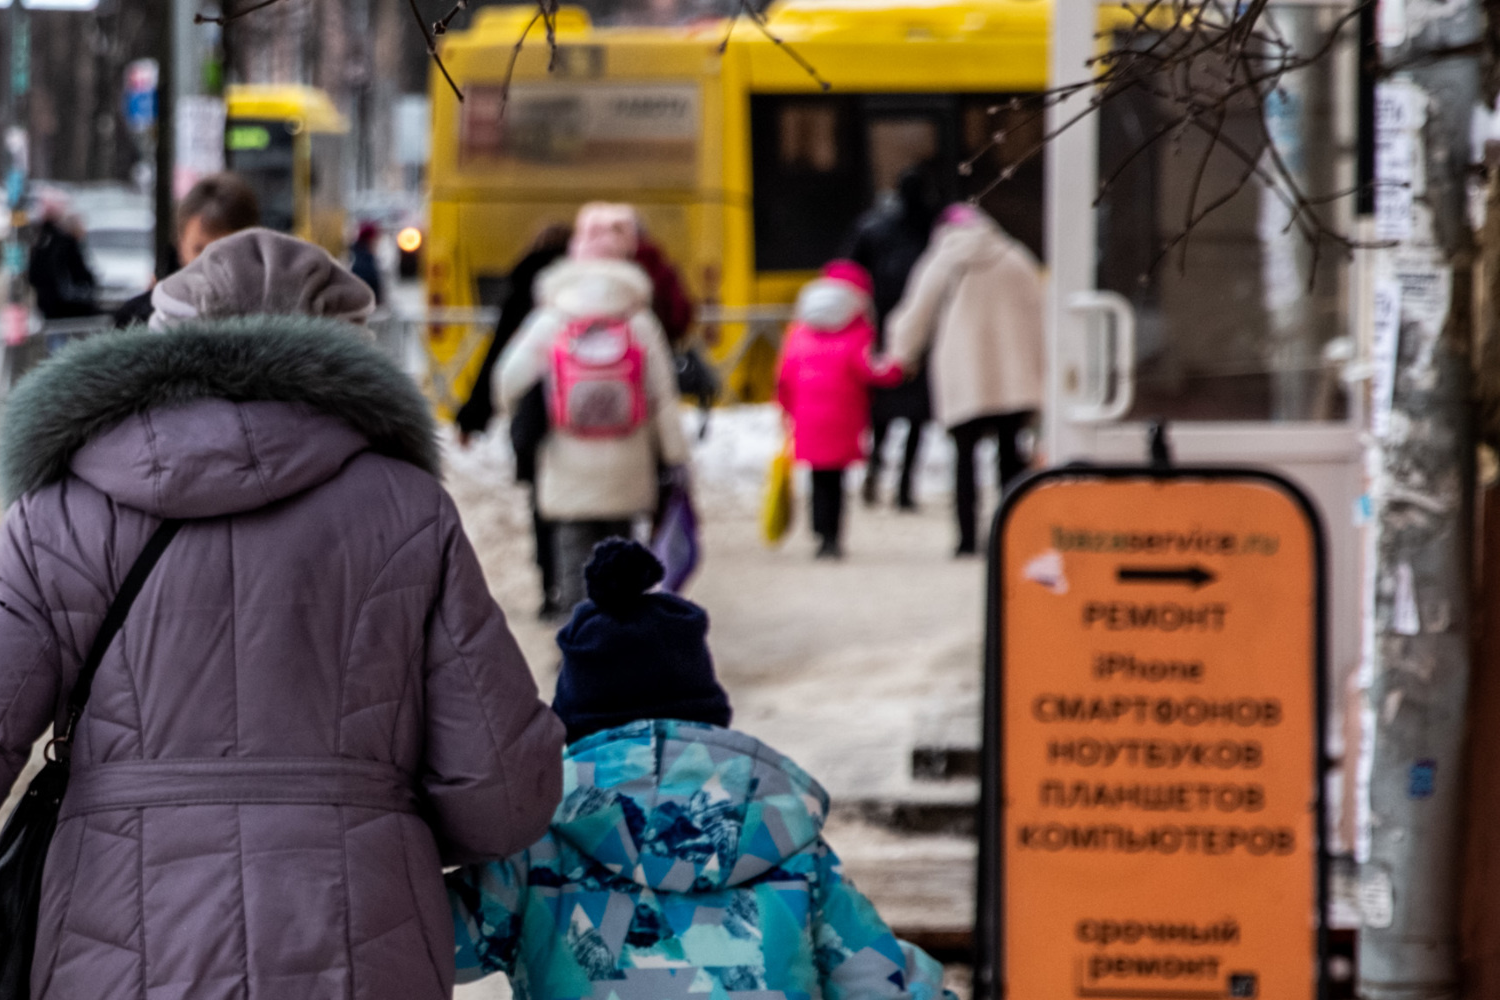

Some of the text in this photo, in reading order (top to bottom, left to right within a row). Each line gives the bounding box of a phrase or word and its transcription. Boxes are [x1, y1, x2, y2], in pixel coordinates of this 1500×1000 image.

[1082, 602, 1227, 633] РЕМОНТ
[1092, 653, 1204, 682] iPhone
[1032, 694, 1283, 727] СМАРТФОНОВ
[1047, 737, 1263, 769] НОУТБУКОВ
[1040, 780, 1266, 813] ПЛАНШЕТОВ
[1017, 823, 1296, 856] КОМПЬЮТЕРОВ
[1076, 918, 1240, 949] срочный
[1089, 956, 1220, 985] ремонт
